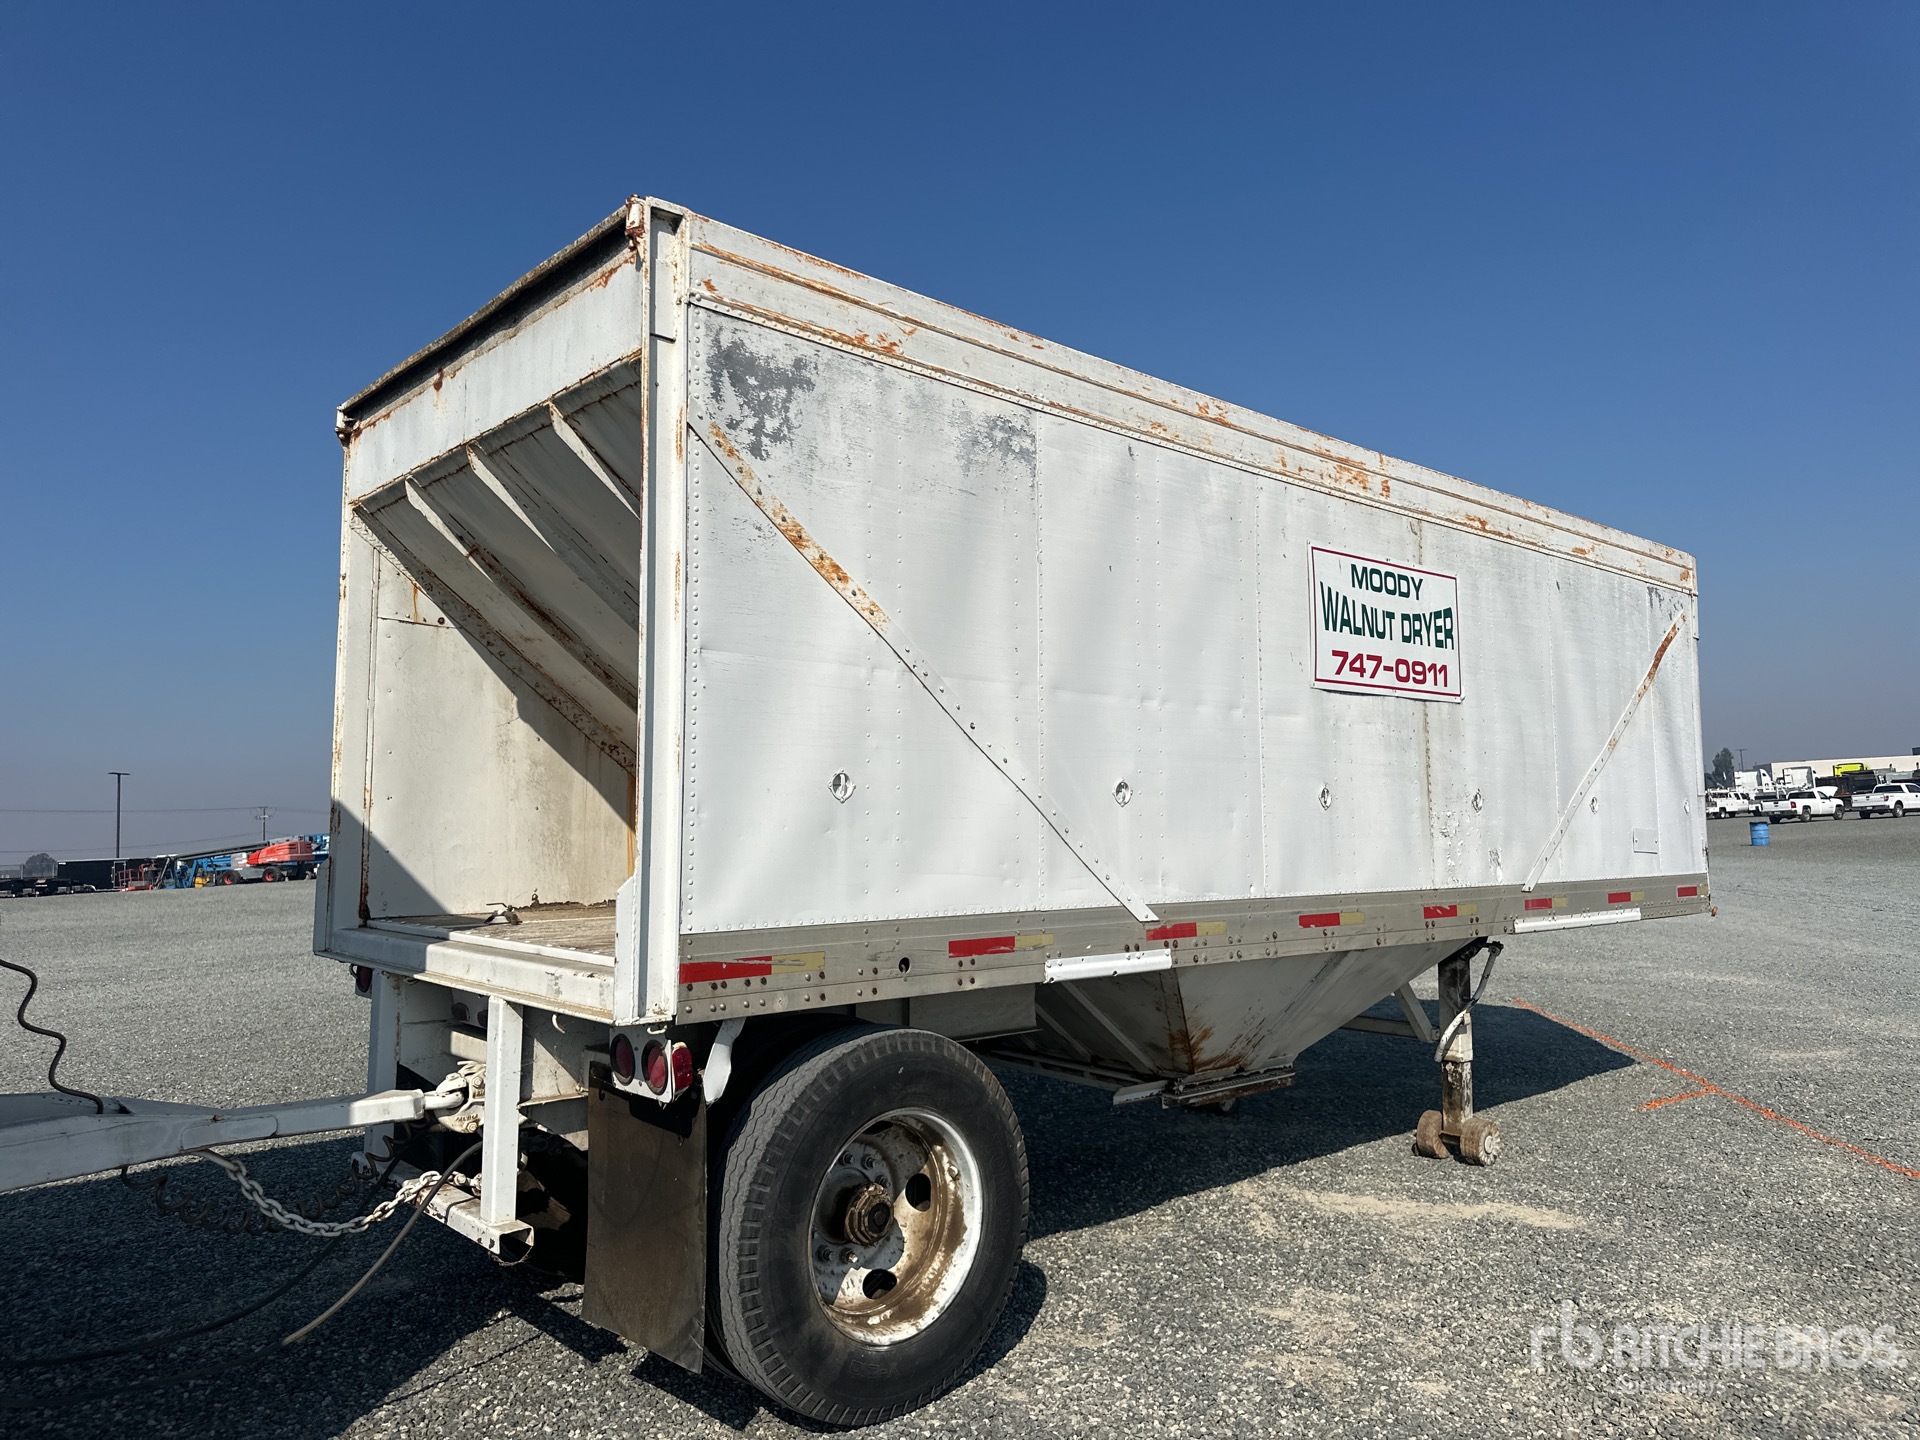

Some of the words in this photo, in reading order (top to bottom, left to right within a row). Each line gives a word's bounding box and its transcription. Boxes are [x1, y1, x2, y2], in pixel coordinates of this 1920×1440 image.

[1351, 563, 1423, 600] MOODY
[1320, 581, 1395, 641] WALNUT
[1401, 607, 1455, 650] DRYER
[1332, 650, 1448, 687] 747-0911
